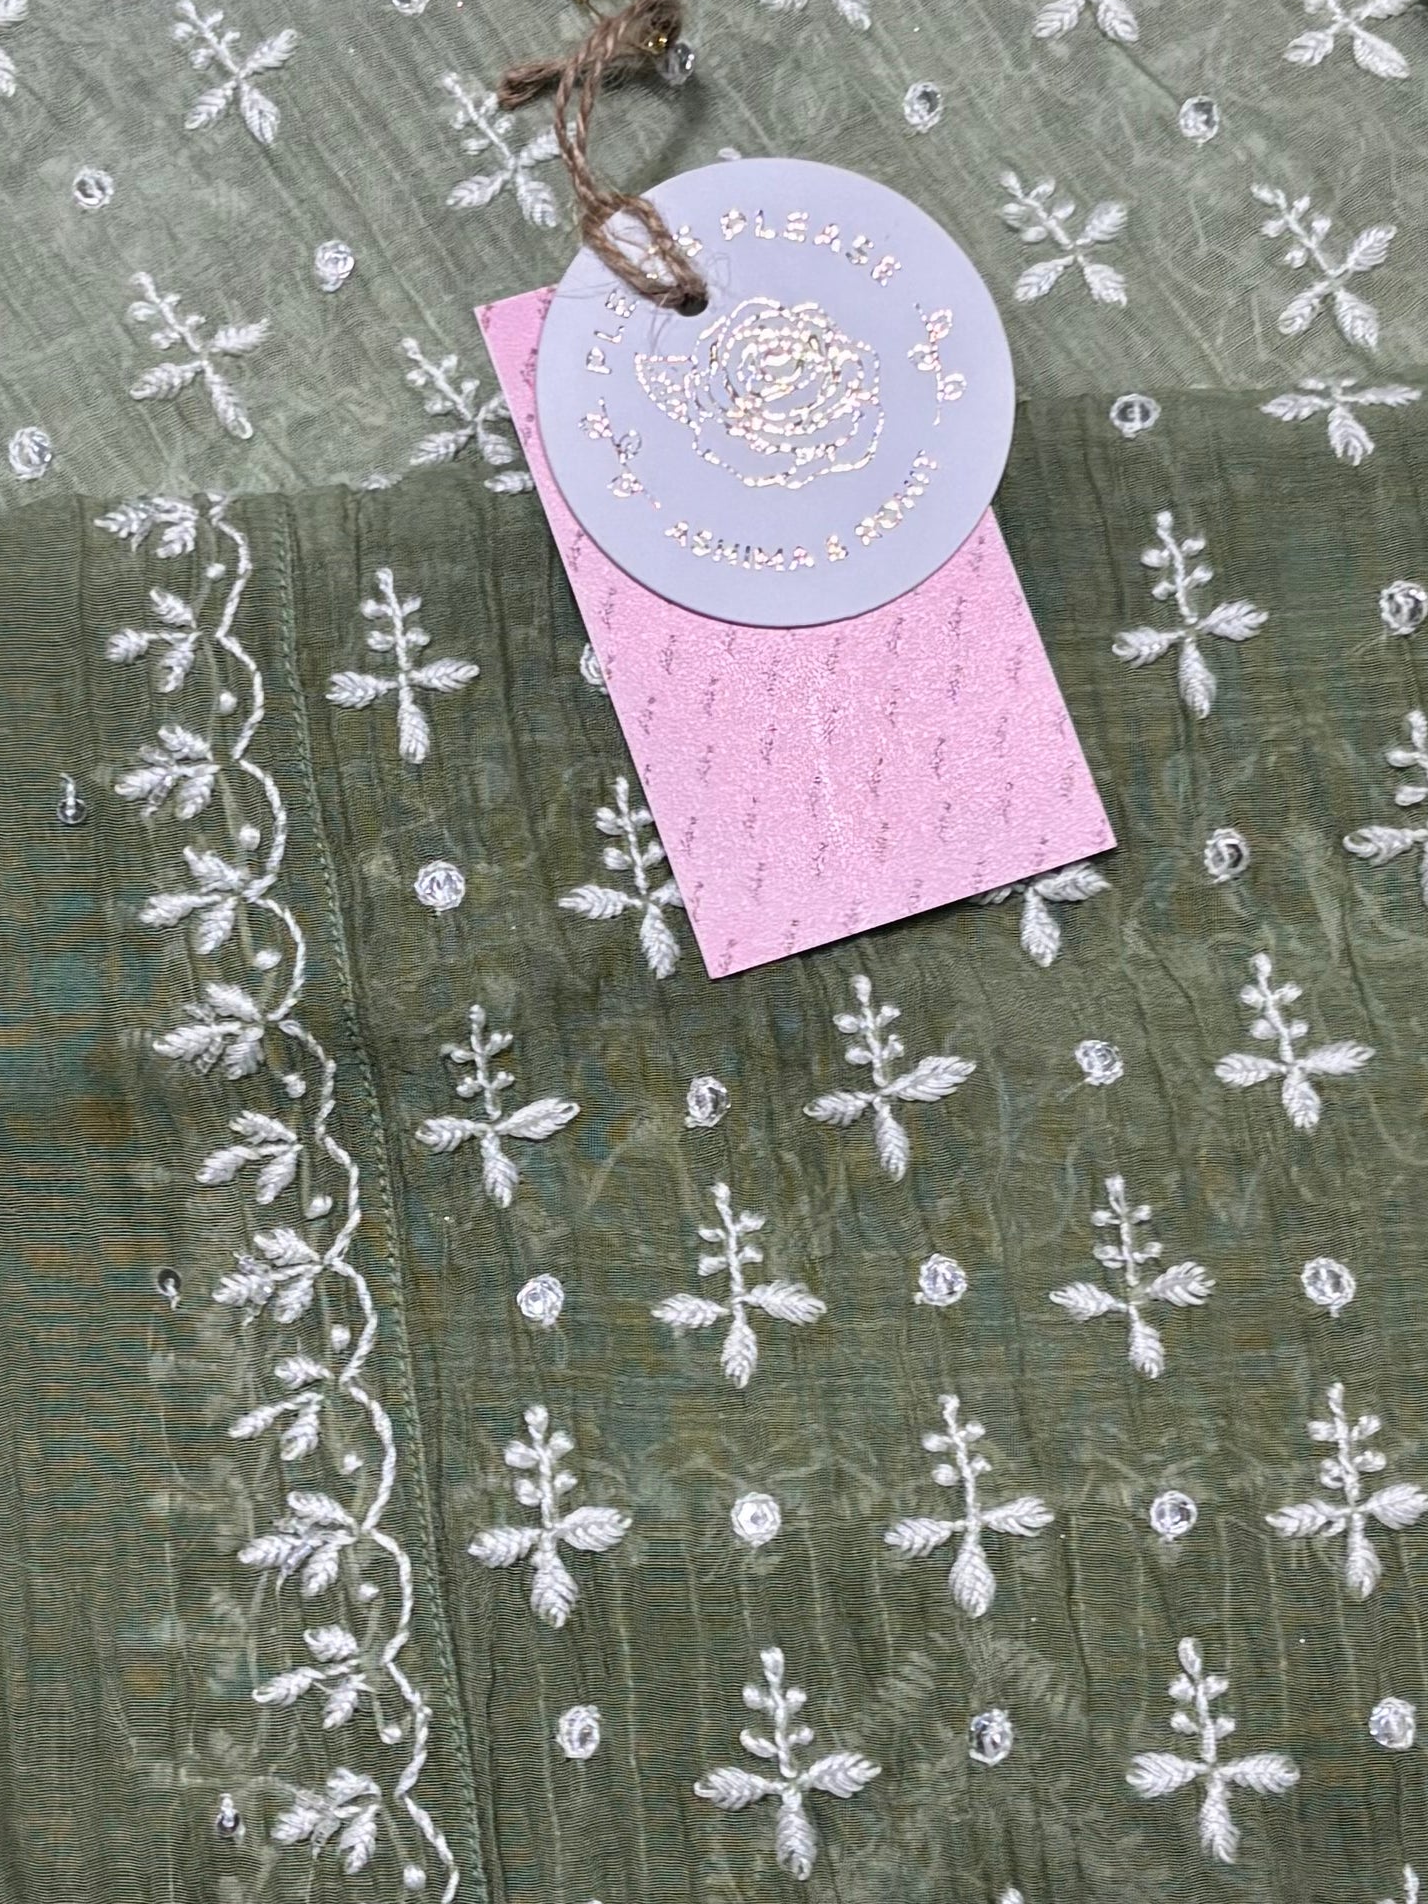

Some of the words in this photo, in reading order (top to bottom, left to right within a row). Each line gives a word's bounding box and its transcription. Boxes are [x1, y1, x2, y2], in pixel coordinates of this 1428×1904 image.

[586, 224, 703, 375] PLES
[720, 209, 902, 286] PLEASE
[664, 521, 815, 571] ASHIMA
[826, 534, 850, 562] &
